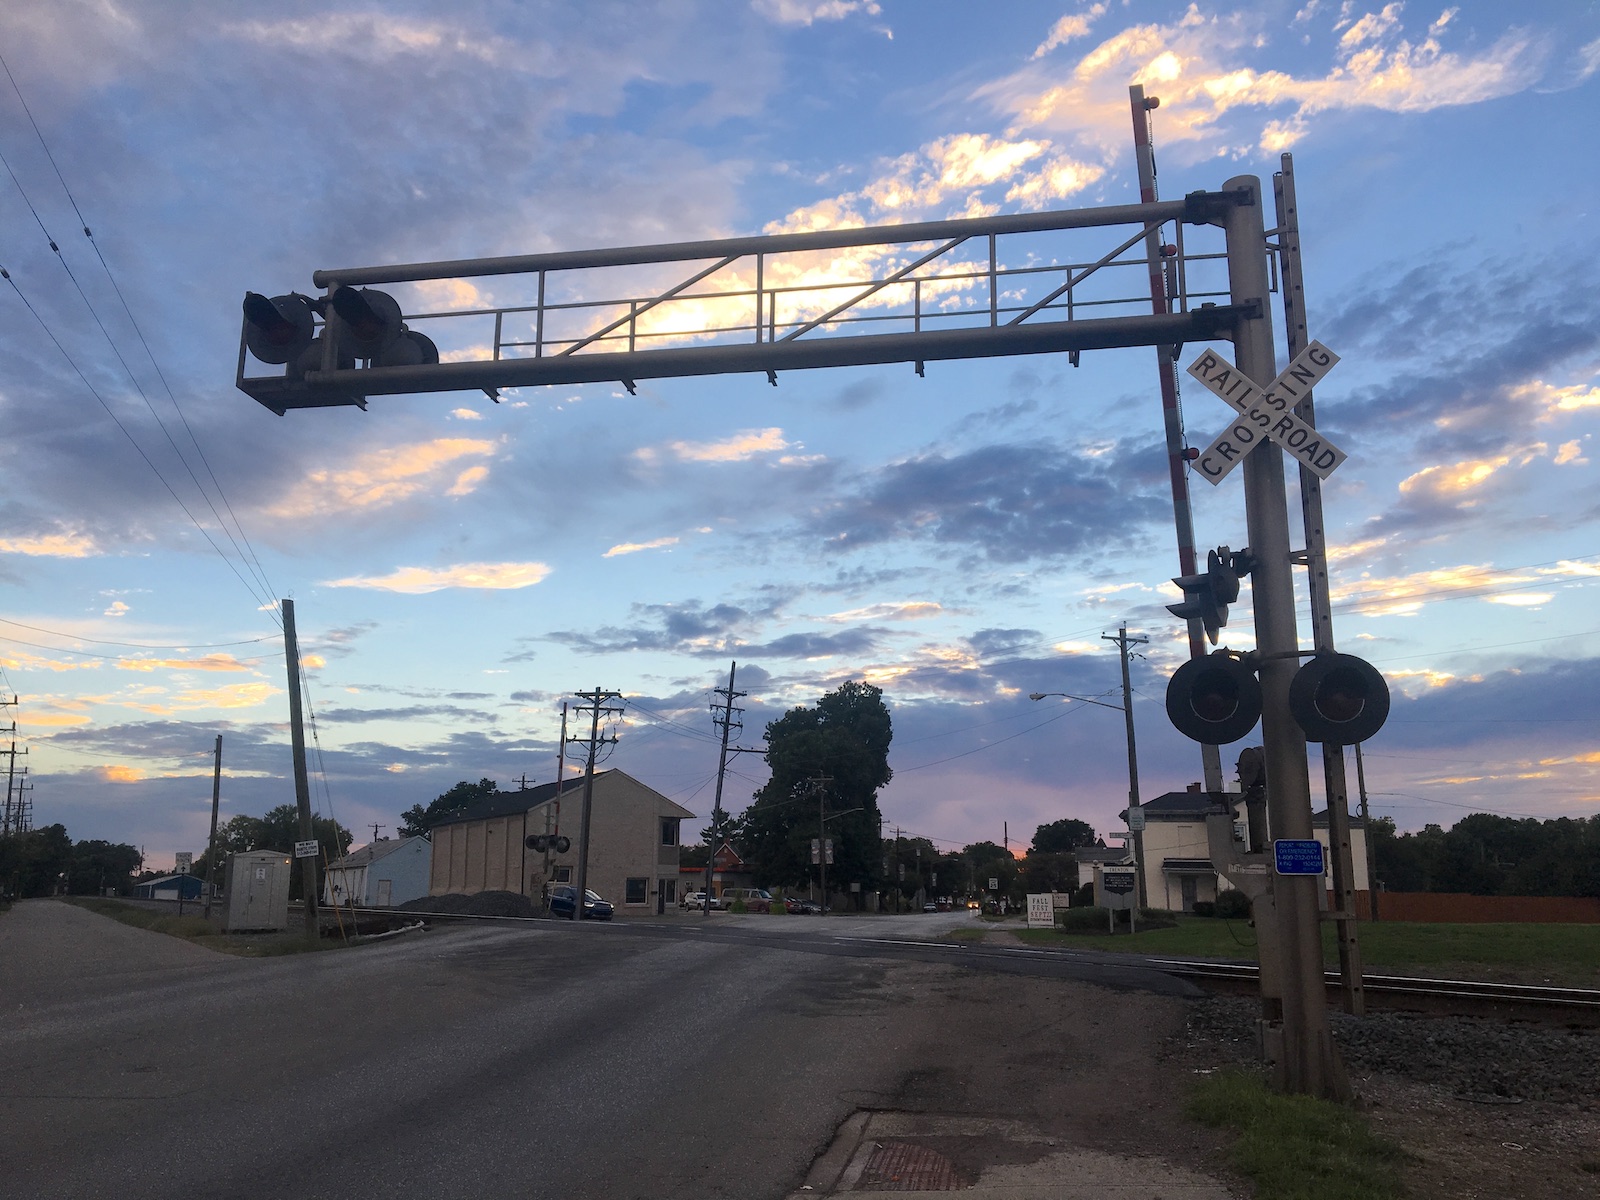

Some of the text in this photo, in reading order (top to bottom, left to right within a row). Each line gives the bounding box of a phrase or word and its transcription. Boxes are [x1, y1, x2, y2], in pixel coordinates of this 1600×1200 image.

[1195, 354, 1336, 470] RAIL ROAD
[1201, 348, 1330, 476] CROSSING
